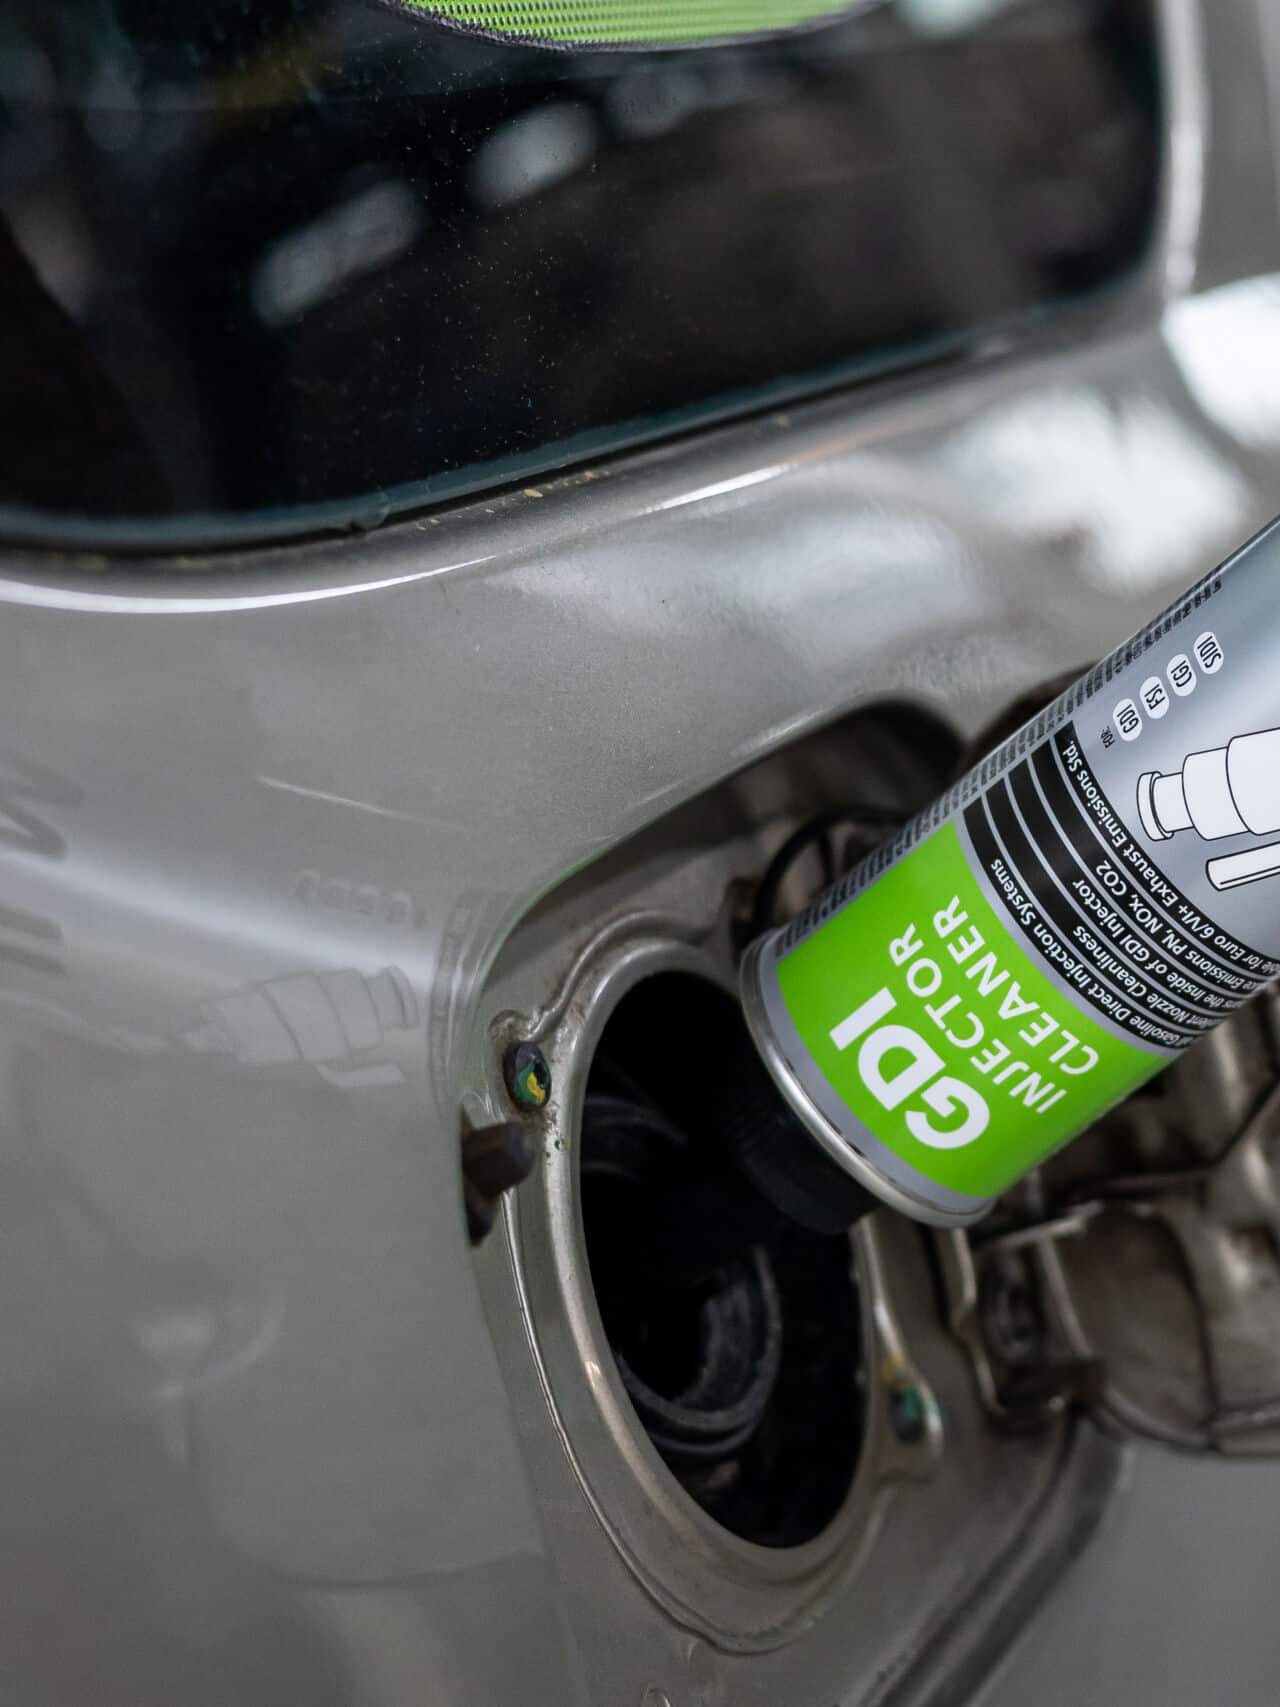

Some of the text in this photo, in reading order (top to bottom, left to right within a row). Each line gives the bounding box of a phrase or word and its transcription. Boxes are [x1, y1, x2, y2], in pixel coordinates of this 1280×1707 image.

[1197, 635, 1222, 669] SIDI
[1171, 660, 1192, 688] CGI
[1144, 684, 1165, 710] FSI
[1117, 704, 1139, 733] GDI
[1062, 740, 1082, 772] Std.
[1076, 770, 1127, 847] Emissions
[991, 859, 1036, 925] Systems
[1123, 844, 1178, 907] Exhaust
[1072, 880, 1124, 938] Injector
[1096, 860, 1243, 988] Emissions PN, NOx, CO2
[1178, 905, 1214, 938] 6/VI+
[1032, 917, 1091, 988] Injection
[1119, 934, 1150, 961] GDI
[1214, 935, 1246, 960] Euro
[1241, 953, 1266, 971] for
[1073, 926, 1189, 1028] Nozzle Cleanliness
[1144, 960, 1167, 974] of
[933, 896, 1098, 1074] CLEANER
[1088, 983, 1131, 1020] Direct
[1166, 972, 1206, 1000] Inside
[889, 923, 1067, 1113] INJECTOR
[829, 987, 990, 1149] GDI
